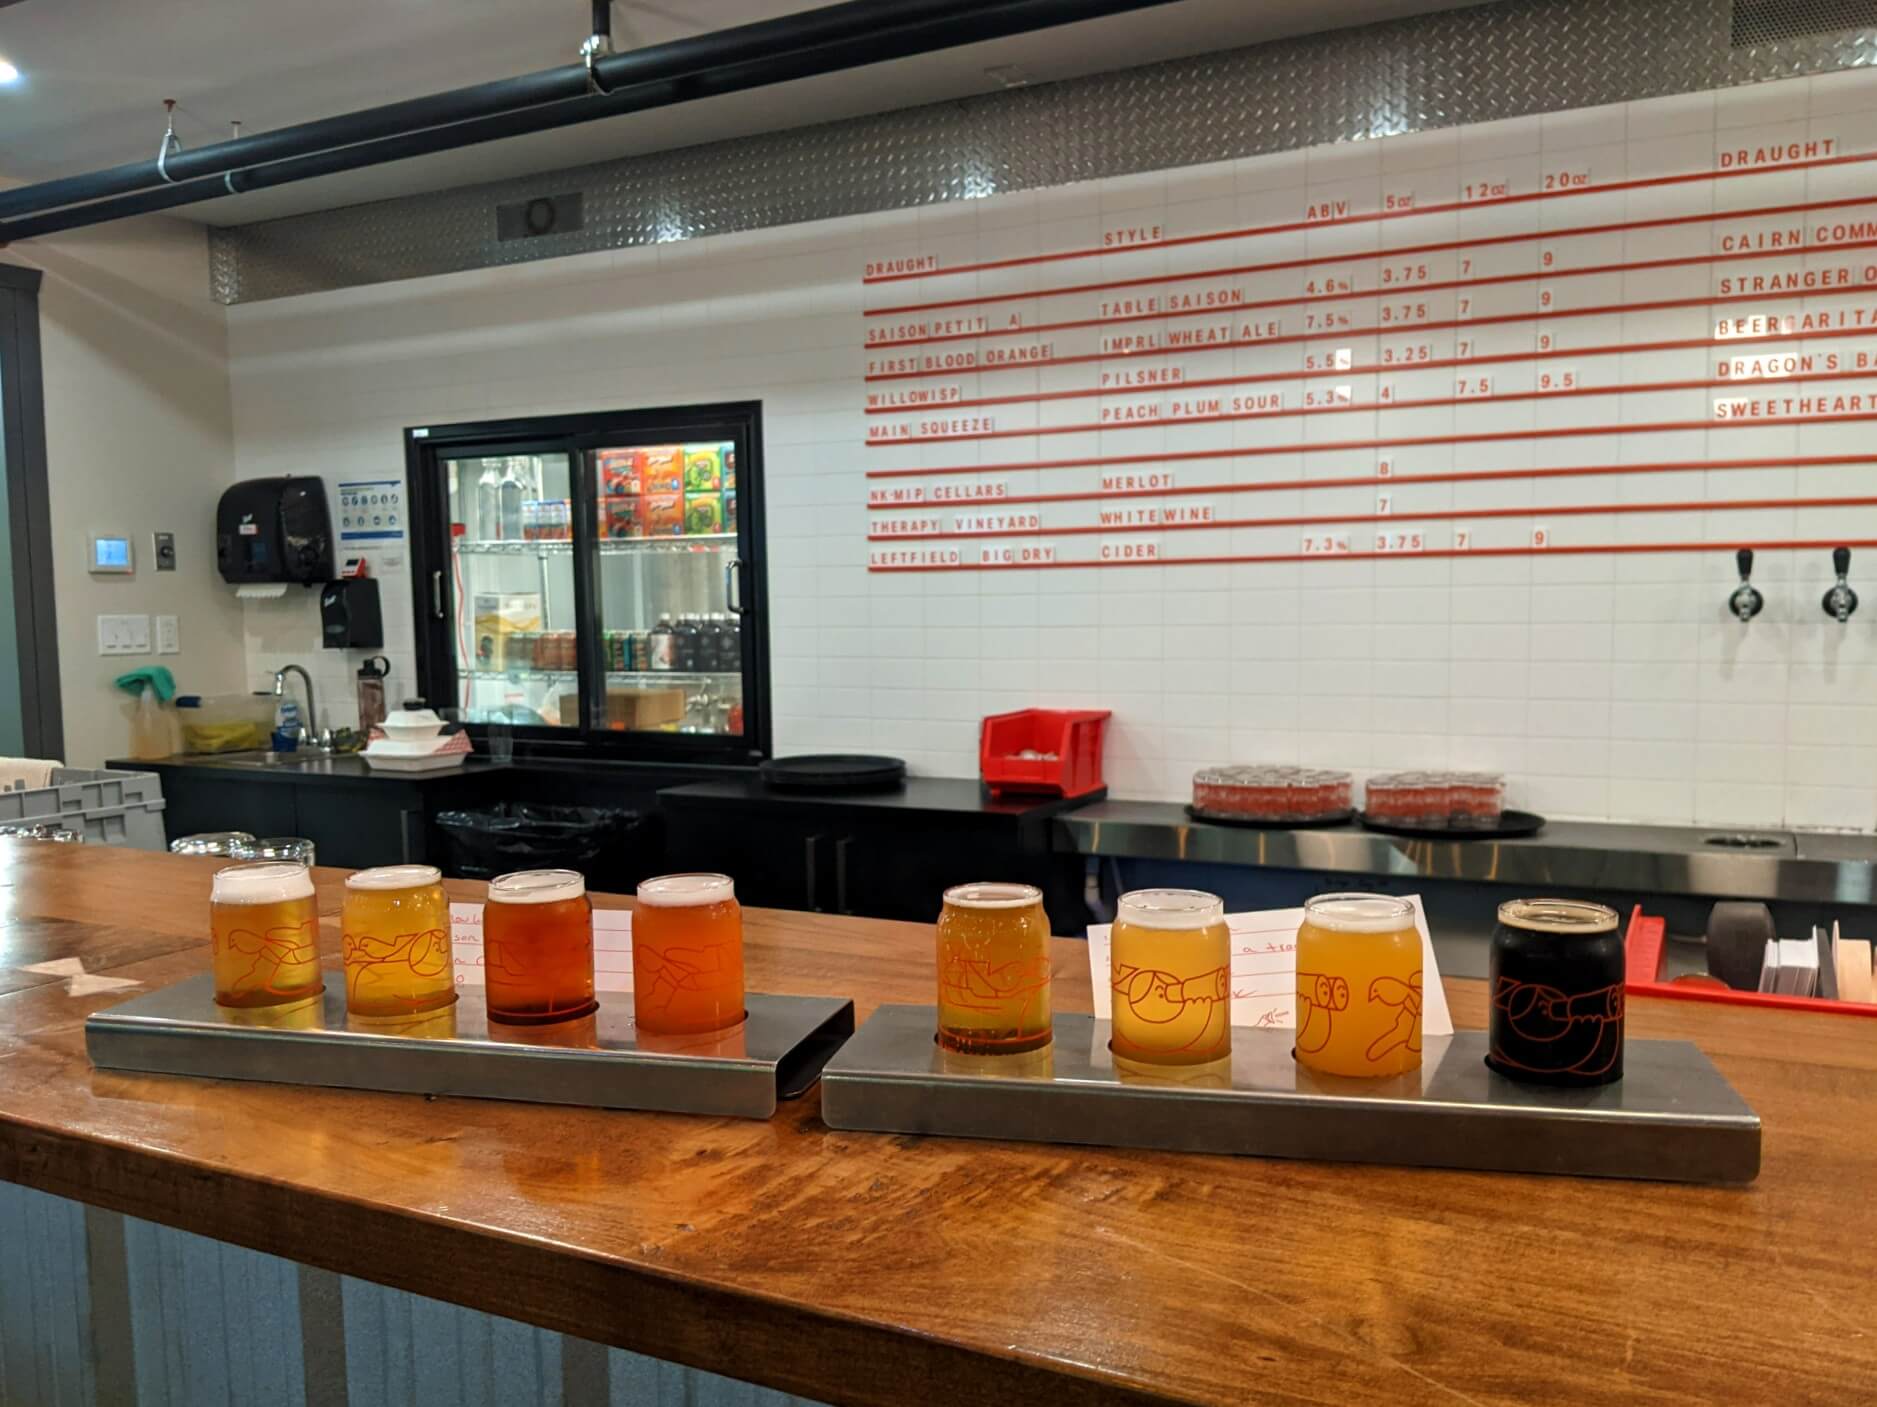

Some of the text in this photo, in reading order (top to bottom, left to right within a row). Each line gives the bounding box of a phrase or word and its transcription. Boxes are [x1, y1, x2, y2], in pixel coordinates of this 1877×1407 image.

[1721, 139, 1834, 168] DRAUGHT
[1307, 201, 1346, 219] ABV
[1104, 226, 1161, 245] STYLE
[1722, 229, 1801, 251] CAIRN
[866, 256, 936, 276] DRAUGHT
[1306, 252, 1553, 294] 4.6% 3.75 7 9
[1720, 268, 1849, 294] STRANGER
[1102, 288, 1242, 316] TABLE SAISON
[1306, 291, 1551, 329] 7.5% 3.75 7 9
[869, 313, 1018, 342] SAISON PETIT A
[1103, 321, 1277, 353] IMPRL WHEAT ALE
[869, 344, 1050, 373] FIRST BLOOD ORANGE
[1384, 345, 1428, 363] 3.25
[1460, 342, 1469, 356] 7
[1540, 335, 1550, 349] 9
[1718, 352, 1877, 377] DRAGON'S B
[1102, 367, 1182, 385] PILSNER
[1381, 386, 1390, 399] 4
[1458, 378, 1489, 394] 7.5
[1541, 373, 1573, 389] 9.5
[868, 388, 959, 406] WILLOWISP
[1102, 394, 1280, 421] PEACH PLUM SOUR
[1717, 394, 1877, 418] SWEETHEART
[869, 417, 991, 438] MAIN SQUEEZE
[1379, 462, 1389, 474] 8
[934, 483, 1005, 499] CELLARS
[1103, 473, 1170, 489] MERLOT
[1100, 506, 1212, 525] WHITE WINE
[1379, 499, 1388, 511] 7
[872, 515, 1039, 533] THERAPY VINEYARD
[1101, 543, 1156, 558] CIDER
[1304, 531, 1544, 552] 7.3% 3.75 7 9
[871, 548, 1054, 564] LEFTFIELD BIG DRY
